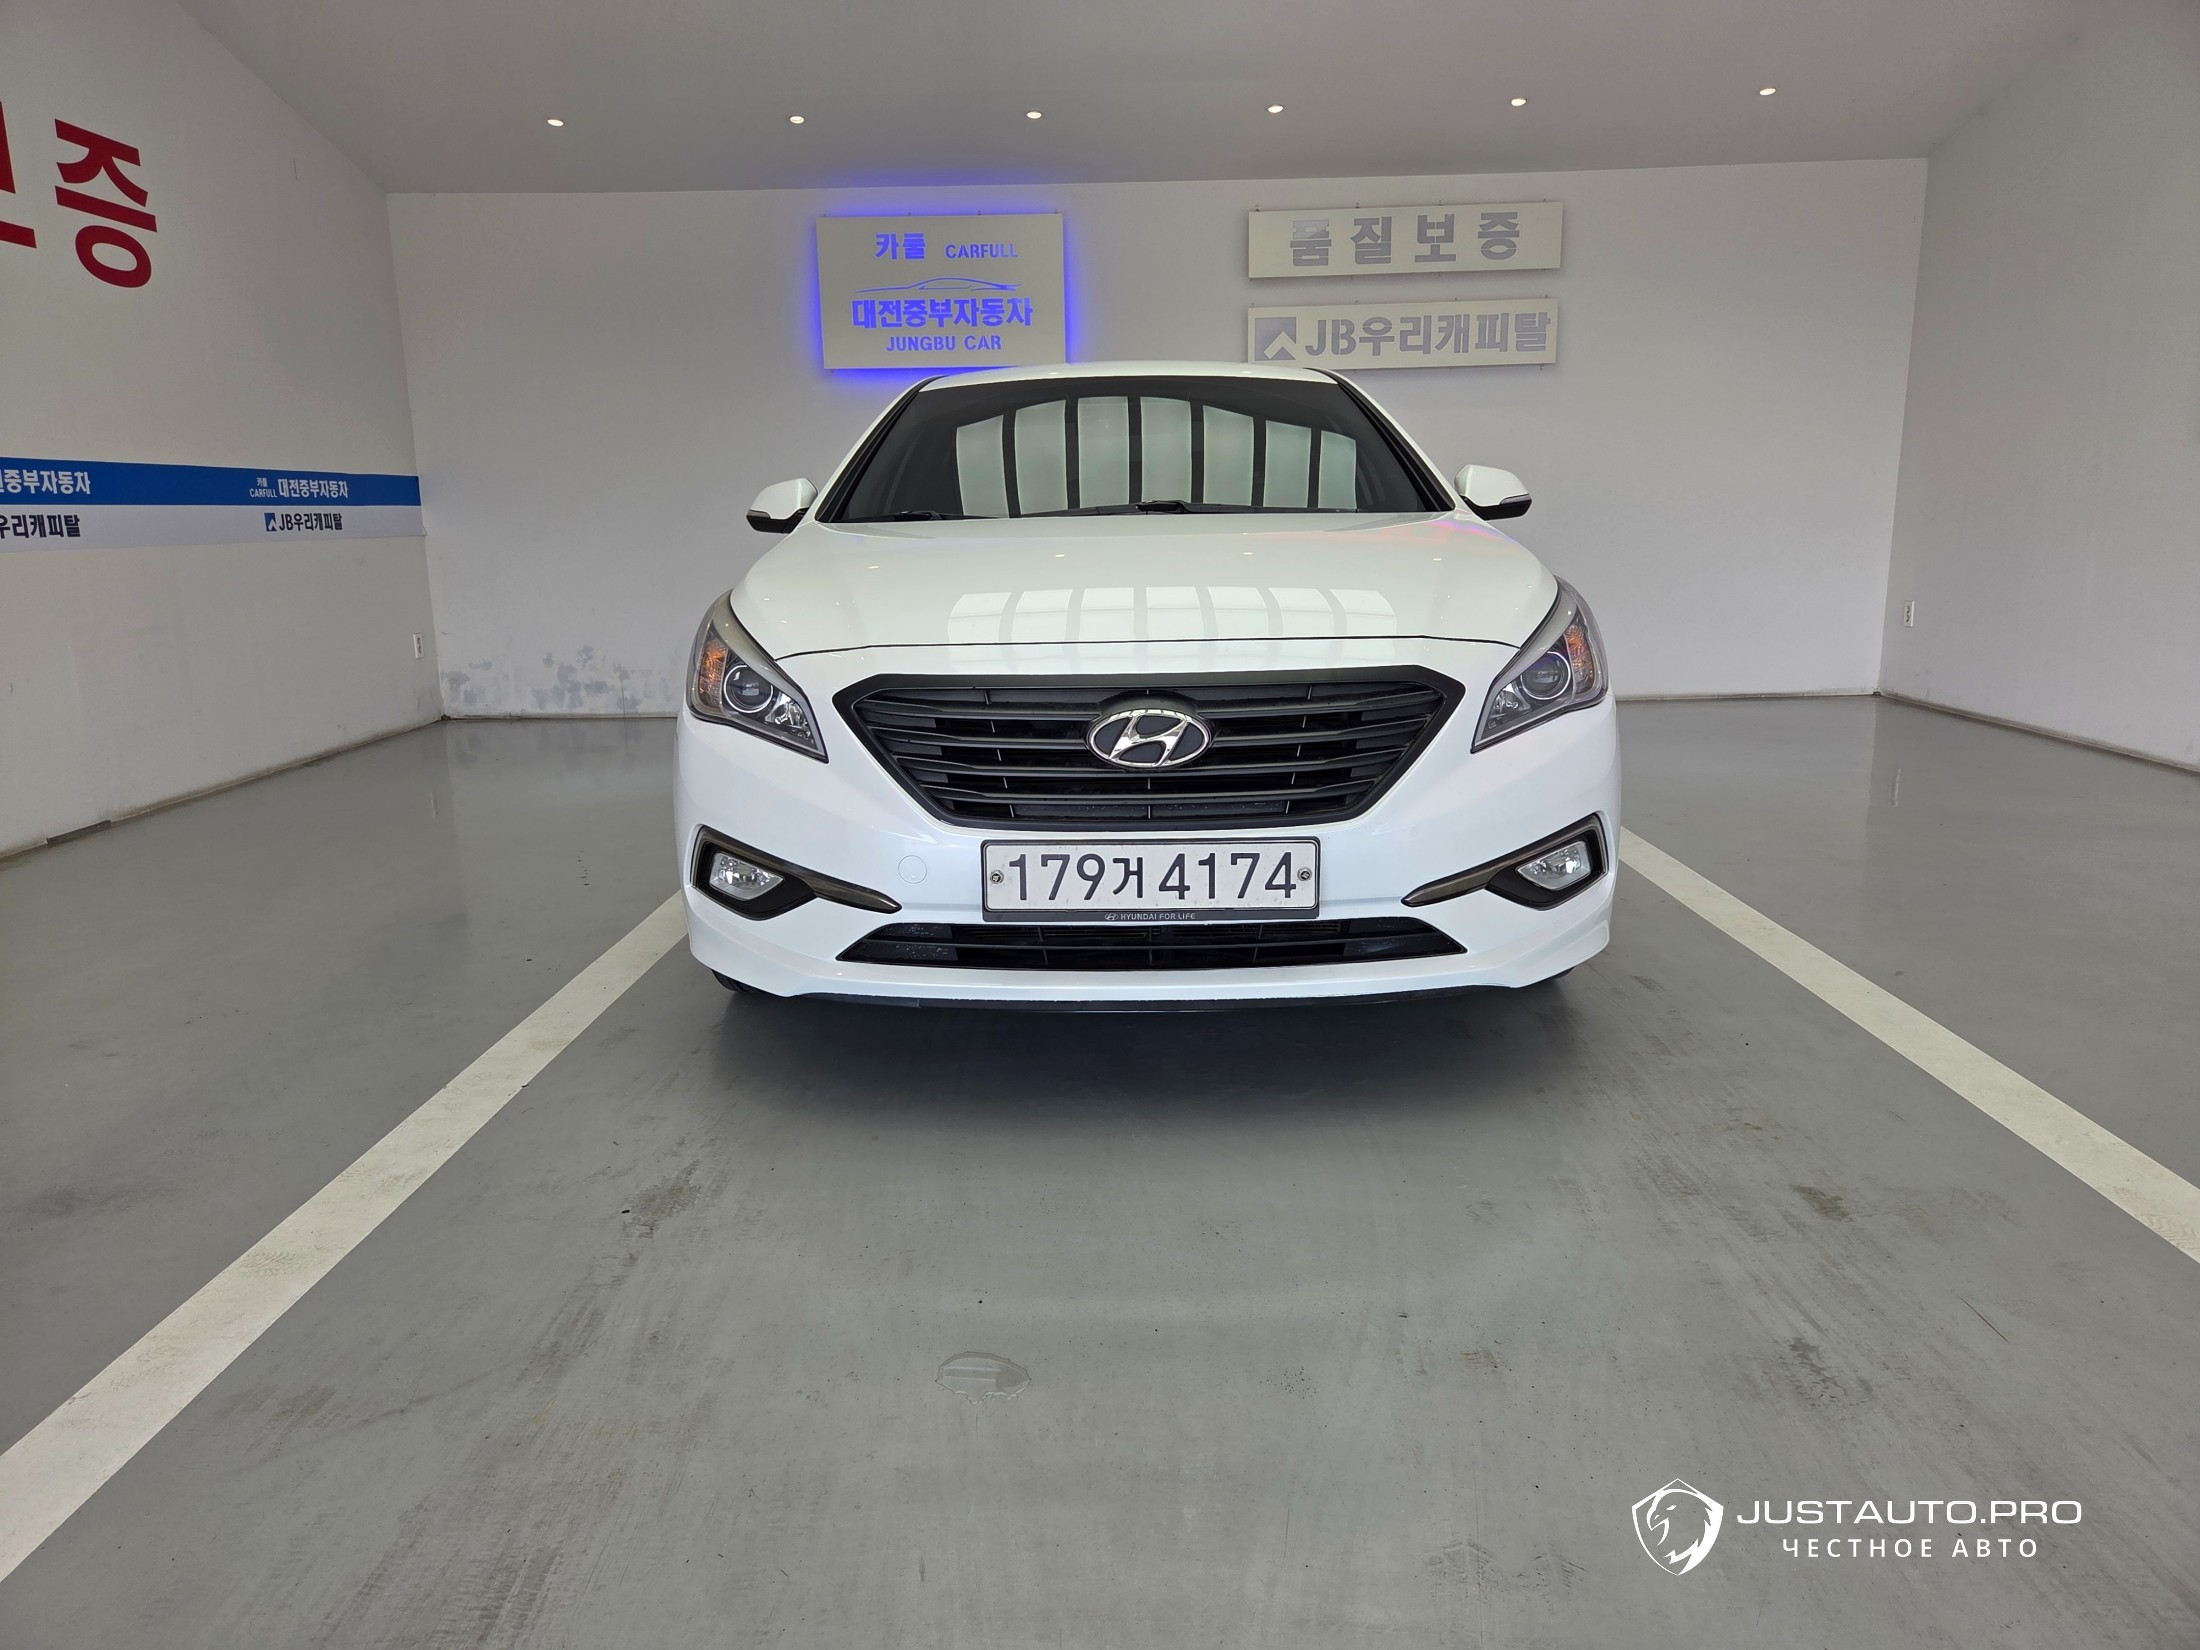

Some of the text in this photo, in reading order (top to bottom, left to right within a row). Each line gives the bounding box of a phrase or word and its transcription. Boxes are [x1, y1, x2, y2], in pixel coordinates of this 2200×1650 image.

[945, 244, 1018, 259] CARFULL
[852, 297, 1034, 328] 대전중부자동차
[886, 335, 1002, 352] JUNGBU CAR
[1305, 312, 1551, 357] JB우리캐피탈
[0, 468, 91, 495] 중부자동차
[278, 479, 348, 498] 대전중부자동차
[249, 488, 277, 498] CARFULL
[279, 512, 343, 531] JB우리캐피탈
[1178, 912, 1196, 920] LIFE
